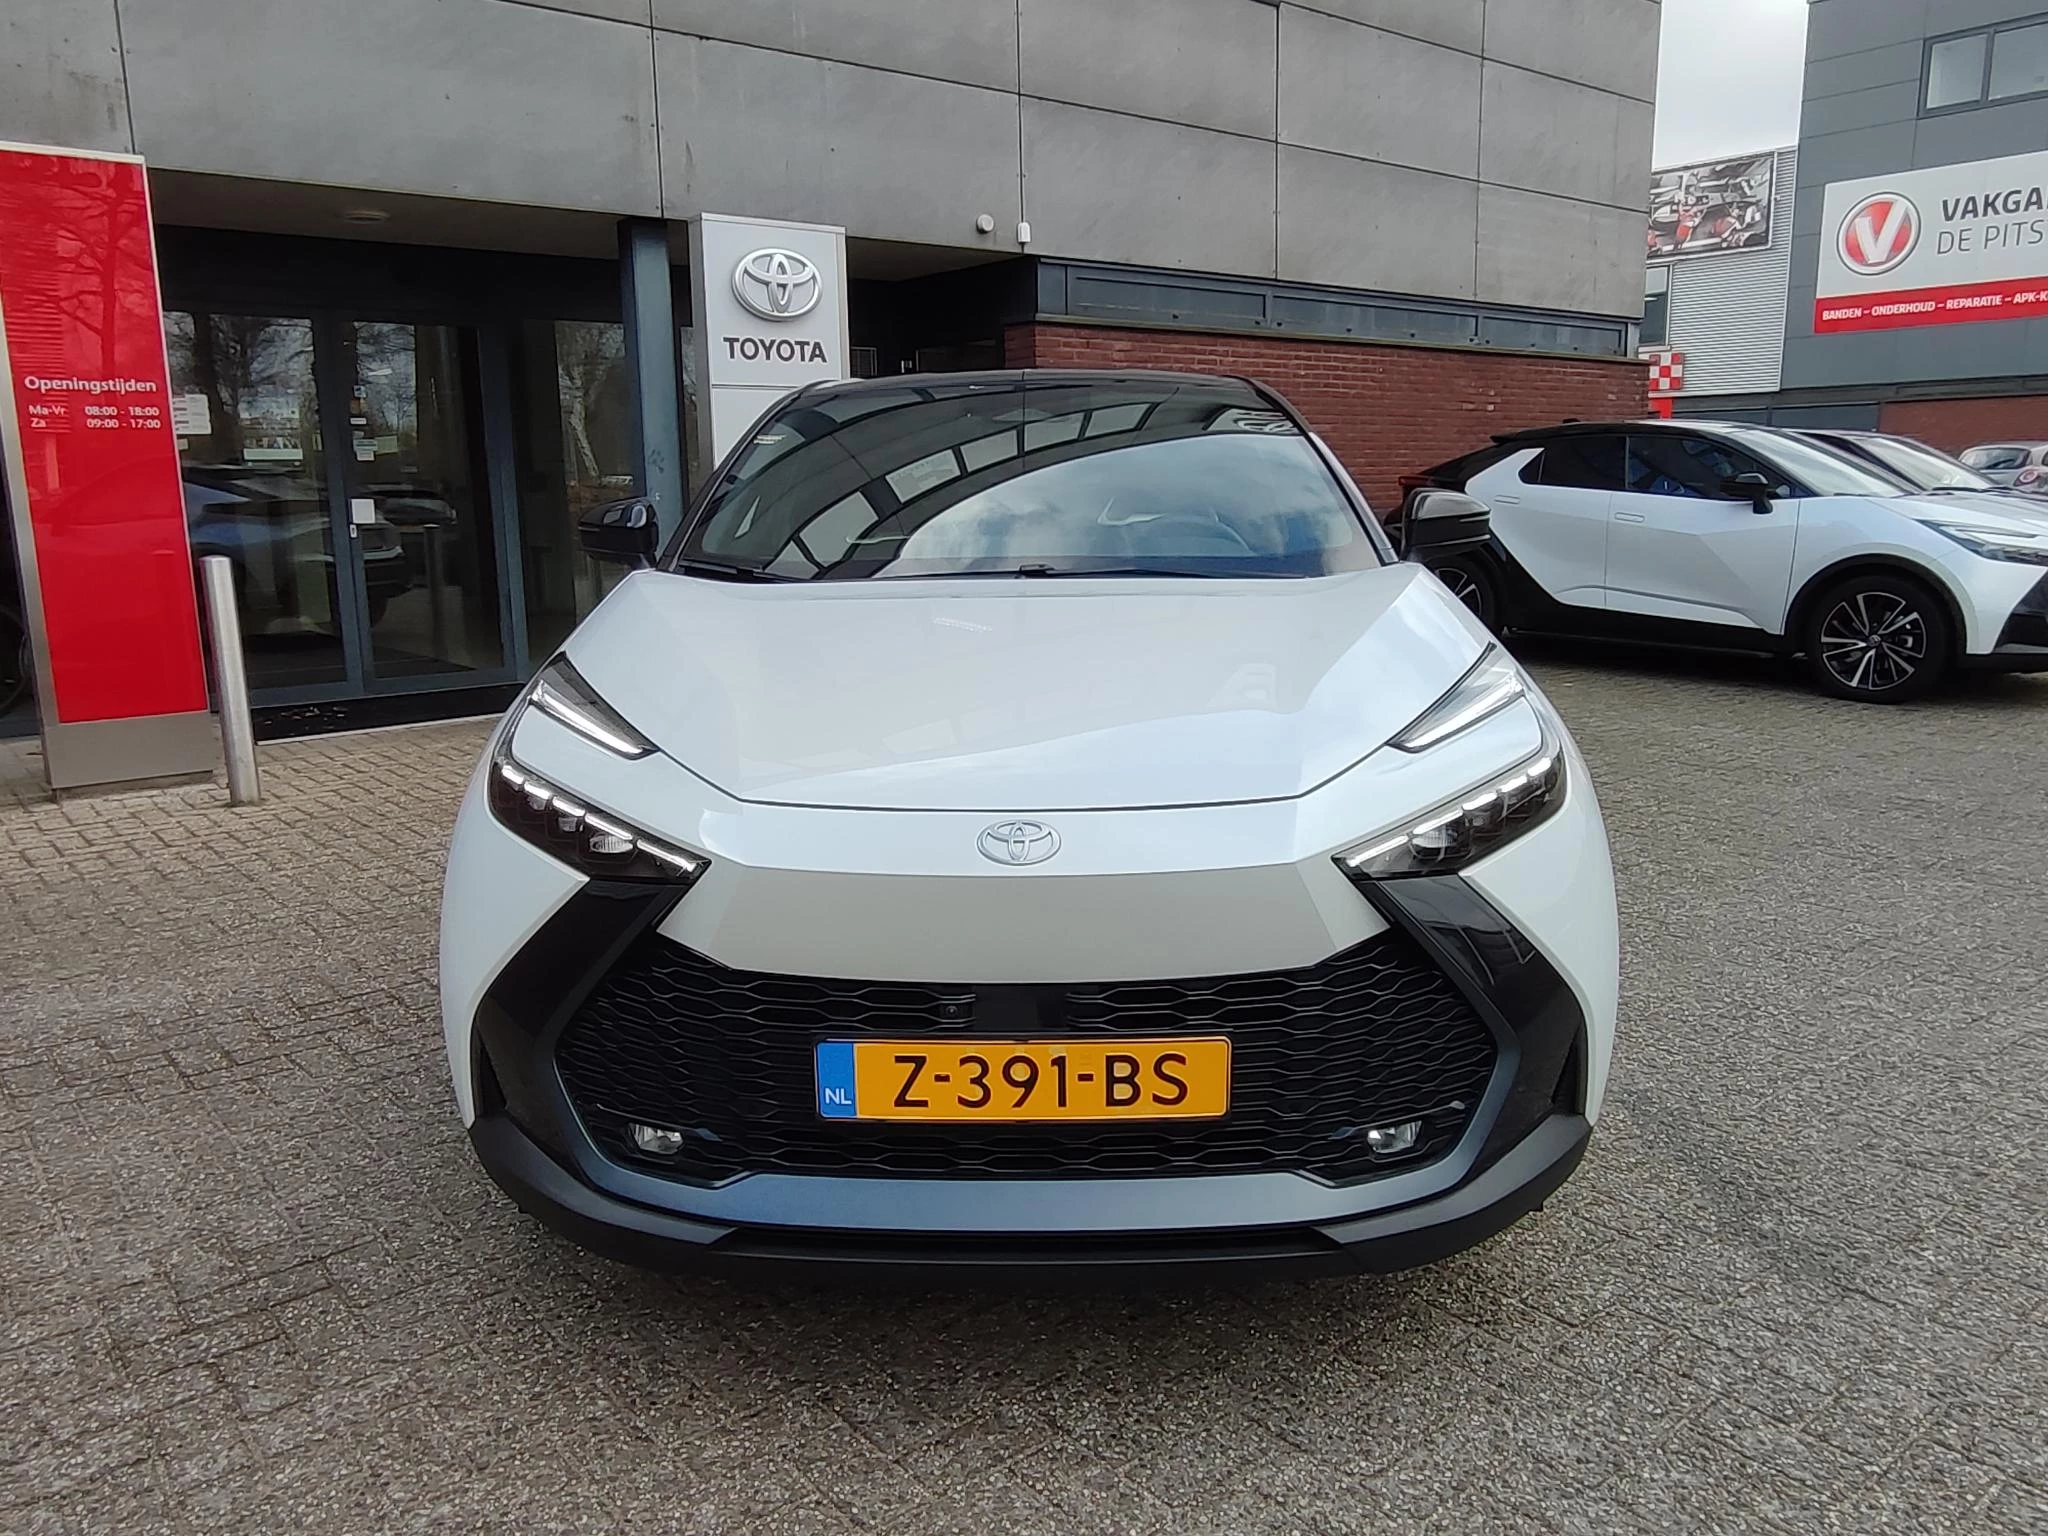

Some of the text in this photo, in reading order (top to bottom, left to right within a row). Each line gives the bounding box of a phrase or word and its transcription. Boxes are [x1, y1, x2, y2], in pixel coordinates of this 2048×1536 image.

[1942, 187, 2048, 222] VAKGA
[1937, 219, 2048, 255] DE PITS
[1822, 307, 1862, 321] BANDEN
[1871, 301, 1935, 317] ONDERHOUD
[1946, 294, 2002, 309] REPARATIE
[723, 336, 828, 363] TOYOTA
[24, 376, 157, 394] Openingstijden
[28, 405, 66, 415] Ma-Vr
[84, 406, 118, 416] 08:00
[128, 406, 160, 416] 18:00
[30, 417, 47, 428] Za
[86, 418, 119, 428] 09:00
[129, 419, 161, 429] 17:00
[893, 1053, 1188, 1109] Z-391-BS
[824, 1088, 852, 1104] NL
